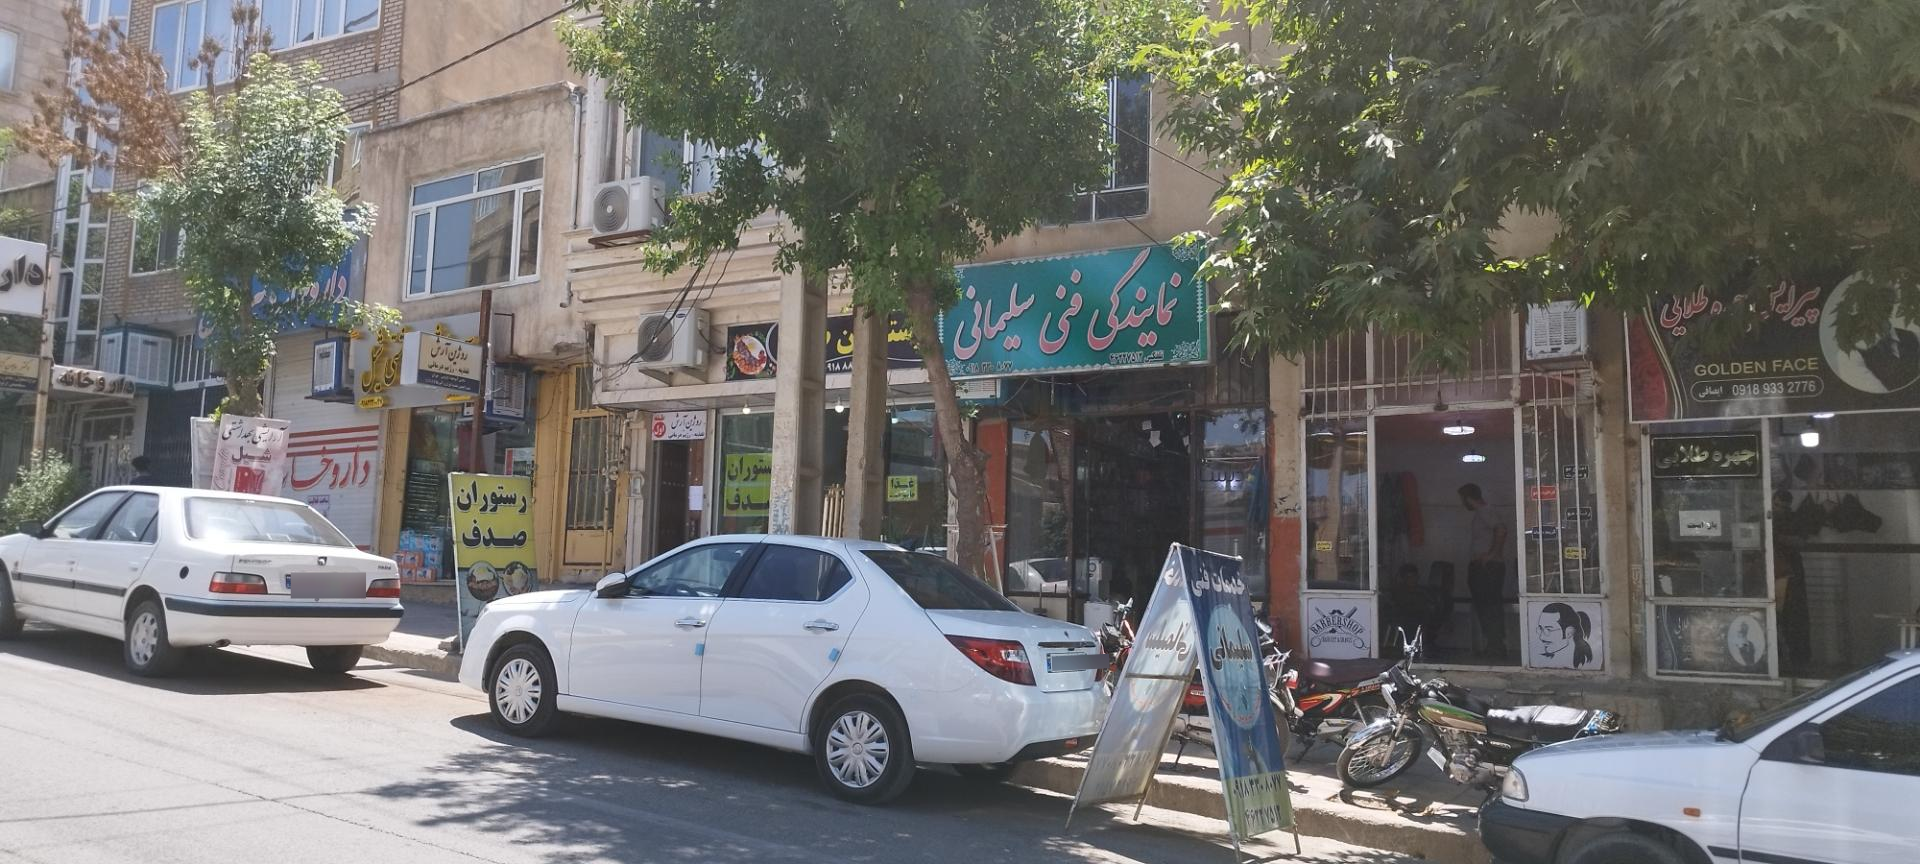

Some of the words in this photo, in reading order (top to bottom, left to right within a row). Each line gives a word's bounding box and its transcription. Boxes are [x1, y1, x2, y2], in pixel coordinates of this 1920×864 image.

[1039, 268, 1083, 354] فنی
[1087, 246, 1183, 351] نمایندگی
[953, 282, 1035, 361] سلیمانی
[826, 362, 841, 371] ۹۱۸
[842, 361, 854, 371] ۸۸
[1694, 361, 1766, 377] GOLDEN
[1772, 357, 1819, 373] FACE
[1732, 384, 1760, 396] 0918
[1763, 382, 1784, 394] 933
[1787, 380, 1816, 393] 2776
[290, 446, 371, 491] داروخا
[727, 456, 772, 481] ستوران
[456, 480, 527, 514] رستوران
[726, 488, 770, 511] دف
[462, 519, 528, 547] صدف
[1310, 616, 1364, 635] BARBERSHOP
